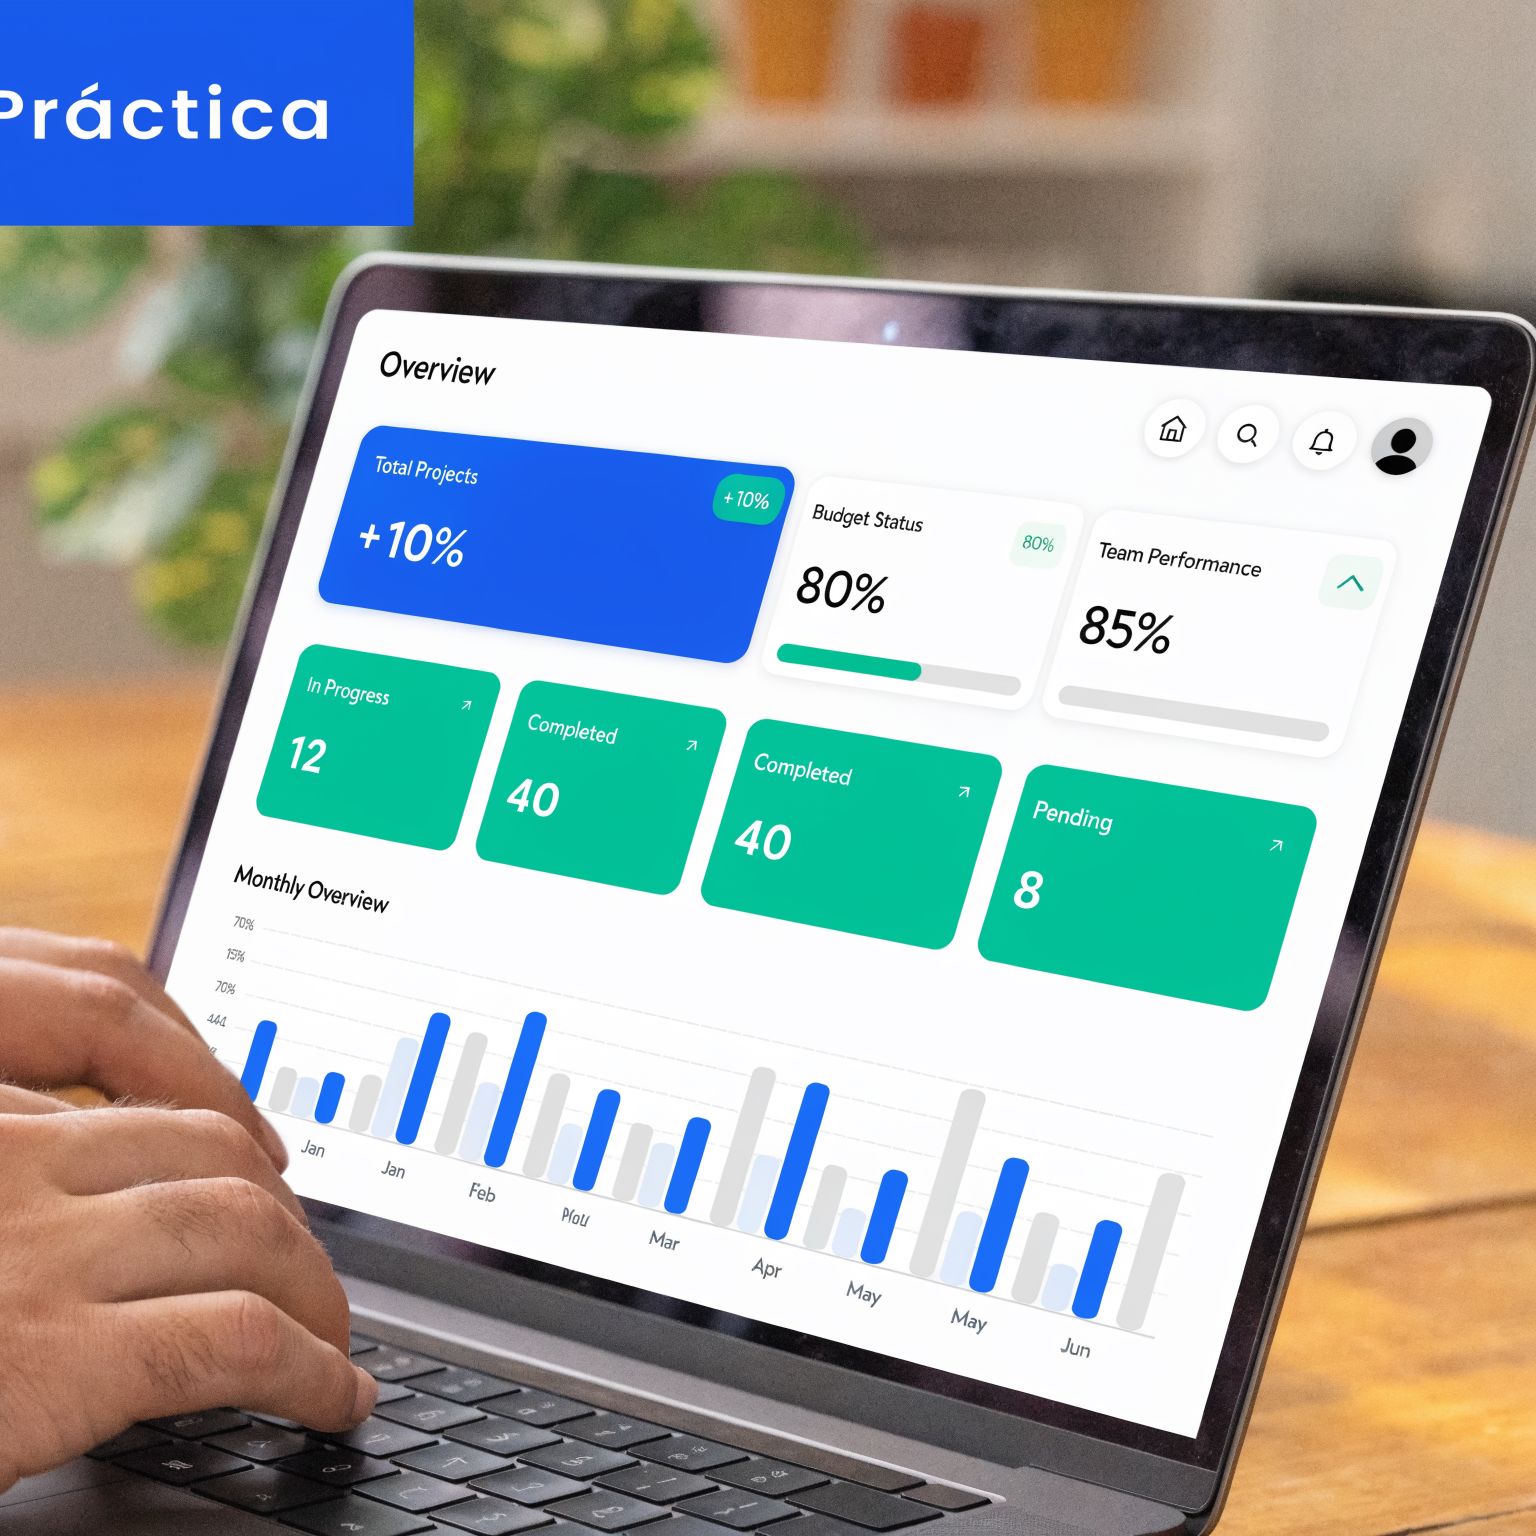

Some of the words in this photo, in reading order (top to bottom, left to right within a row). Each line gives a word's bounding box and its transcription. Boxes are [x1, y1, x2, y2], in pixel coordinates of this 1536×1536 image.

[380, 351, 496, 385] Overview
[376, 456, 413, 476] Total
[415, 461, 478, 485] Projects
[812, 504, 869, 528] Budget
[874, 512, 923, 532] Status
[1023, 535, 1053, 552] 80%
[1100, 542, 1143, 562] Team
[1148, 548, 1261, 577] Performance
[797, 566, 888, 613] 80%
[1080, 606, 1174, 654] 85%
[307, 677, 321, 693] In
[324, 679, 389, 705] Progress
[528, 714, 618, 744] Completed
[291, 736, 326, 773] 12
[754, 753, 853, 786] Completed
[507, 779, 559, 817] 40
[1033, 800, 1113, 835] Pending
[735, 820, 791, 860] 40
[234, 864, 305, 900] Monthly
[308, 881, 389, 913] Overview
[1014, 871, 1043, 909] 8
[301, 1140, 325, 1158] Jan
[381, 1161, 405, 1179] Jan
[469, 1182, 495, 1202] Feb
[649, 1230, 680, 1250] Mar
[752, 1257, 782, 1279] Apr
[847, 1280, 882, 1308] May
[951, 1308, 987, 1335] May
[1061, 1338, 1090, 1358] Jun
